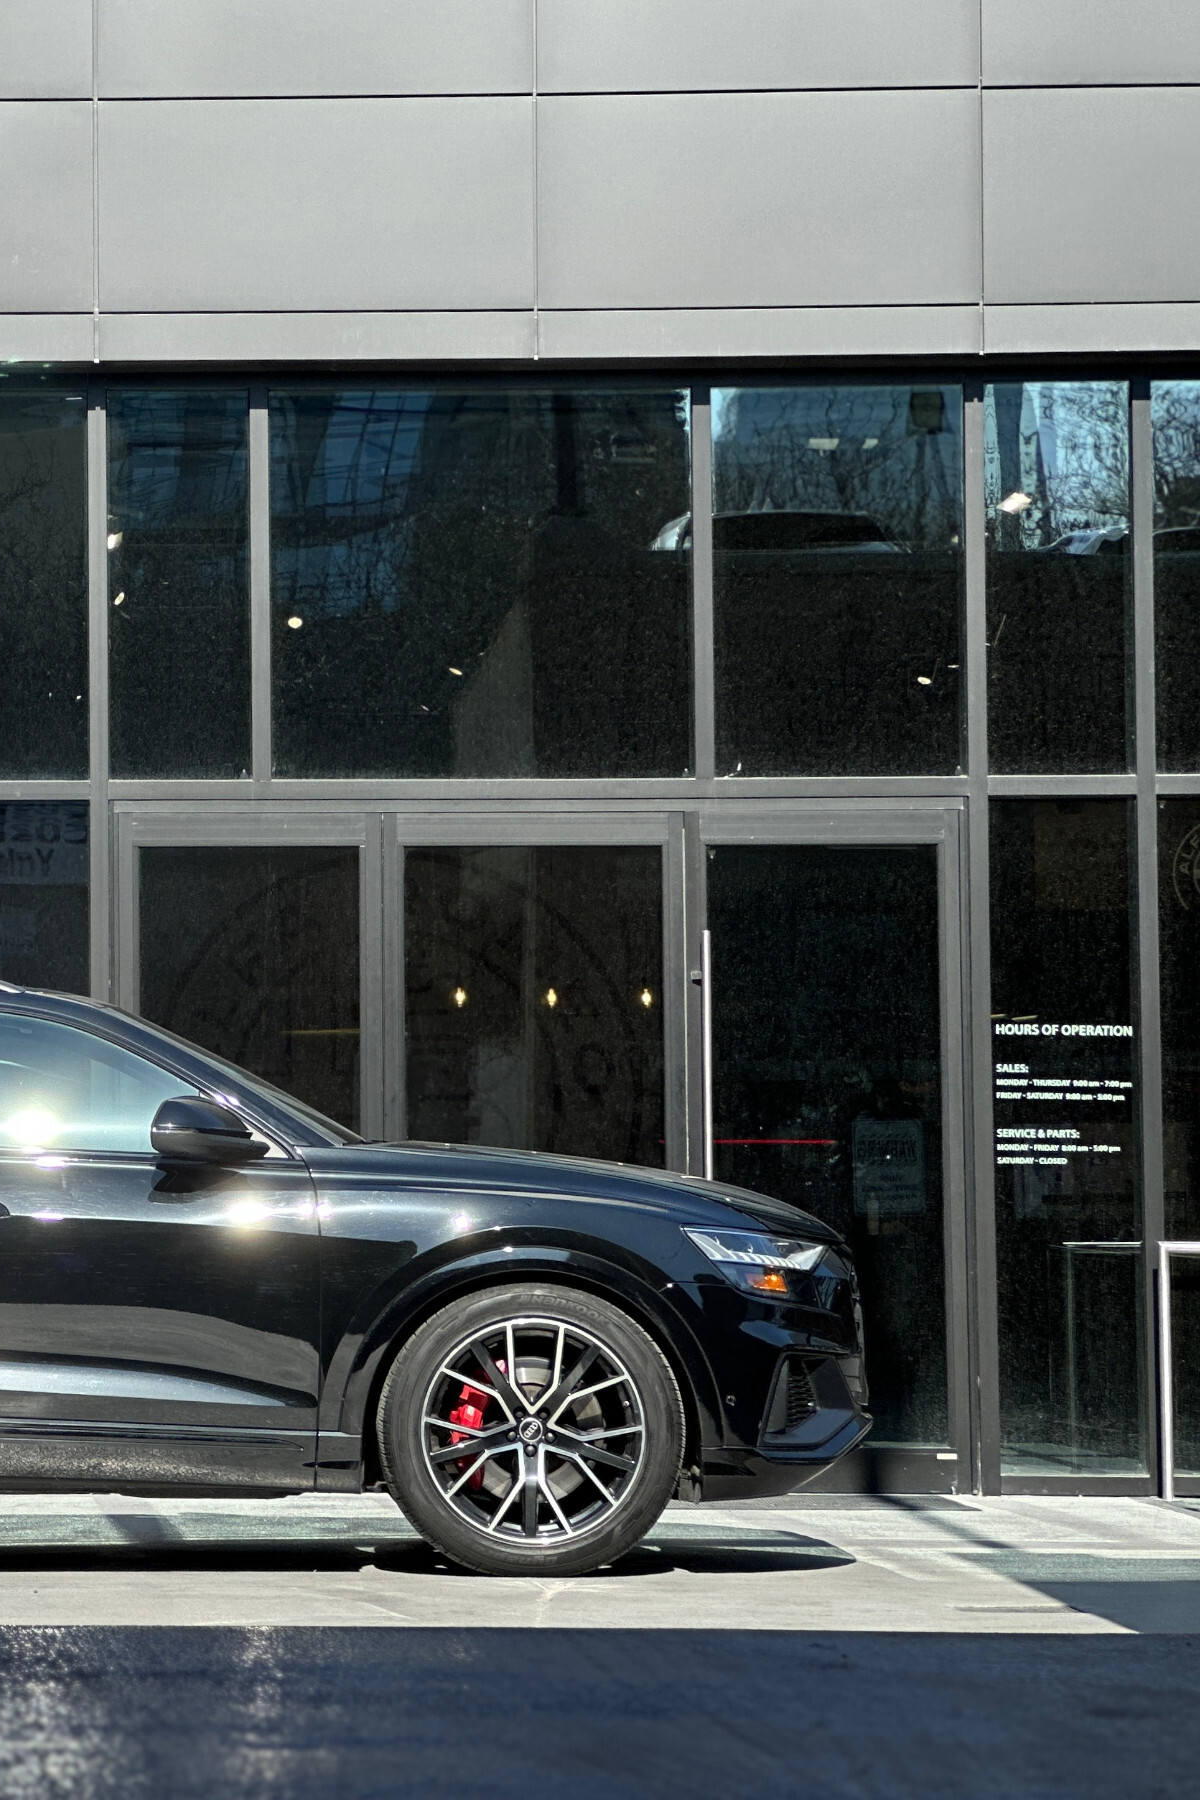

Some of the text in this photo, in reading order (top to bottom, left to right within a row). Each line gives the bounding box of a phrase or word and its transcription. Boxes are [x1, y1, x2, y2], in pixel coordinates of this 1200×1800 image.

[995, 1023, 1133, 1037] HOURS OF OPERATION
[996, 1063, 1029, 1073] SALES:
[996, 1078, 1029, 1086] MONDAY
[1033, 1079, 1071, 1087] THURSDAY
[1026, 1092, 1063, 1100] SATURDAY
[997, 1129, 1080, 1138] SERVICE & PARTS:
[1034, 1144, 1059, 1152] FRIDAY
[997, 1157, 1034, 1165] SATURDAY
[1039, 1157, 1068, 1165] CLOSED
